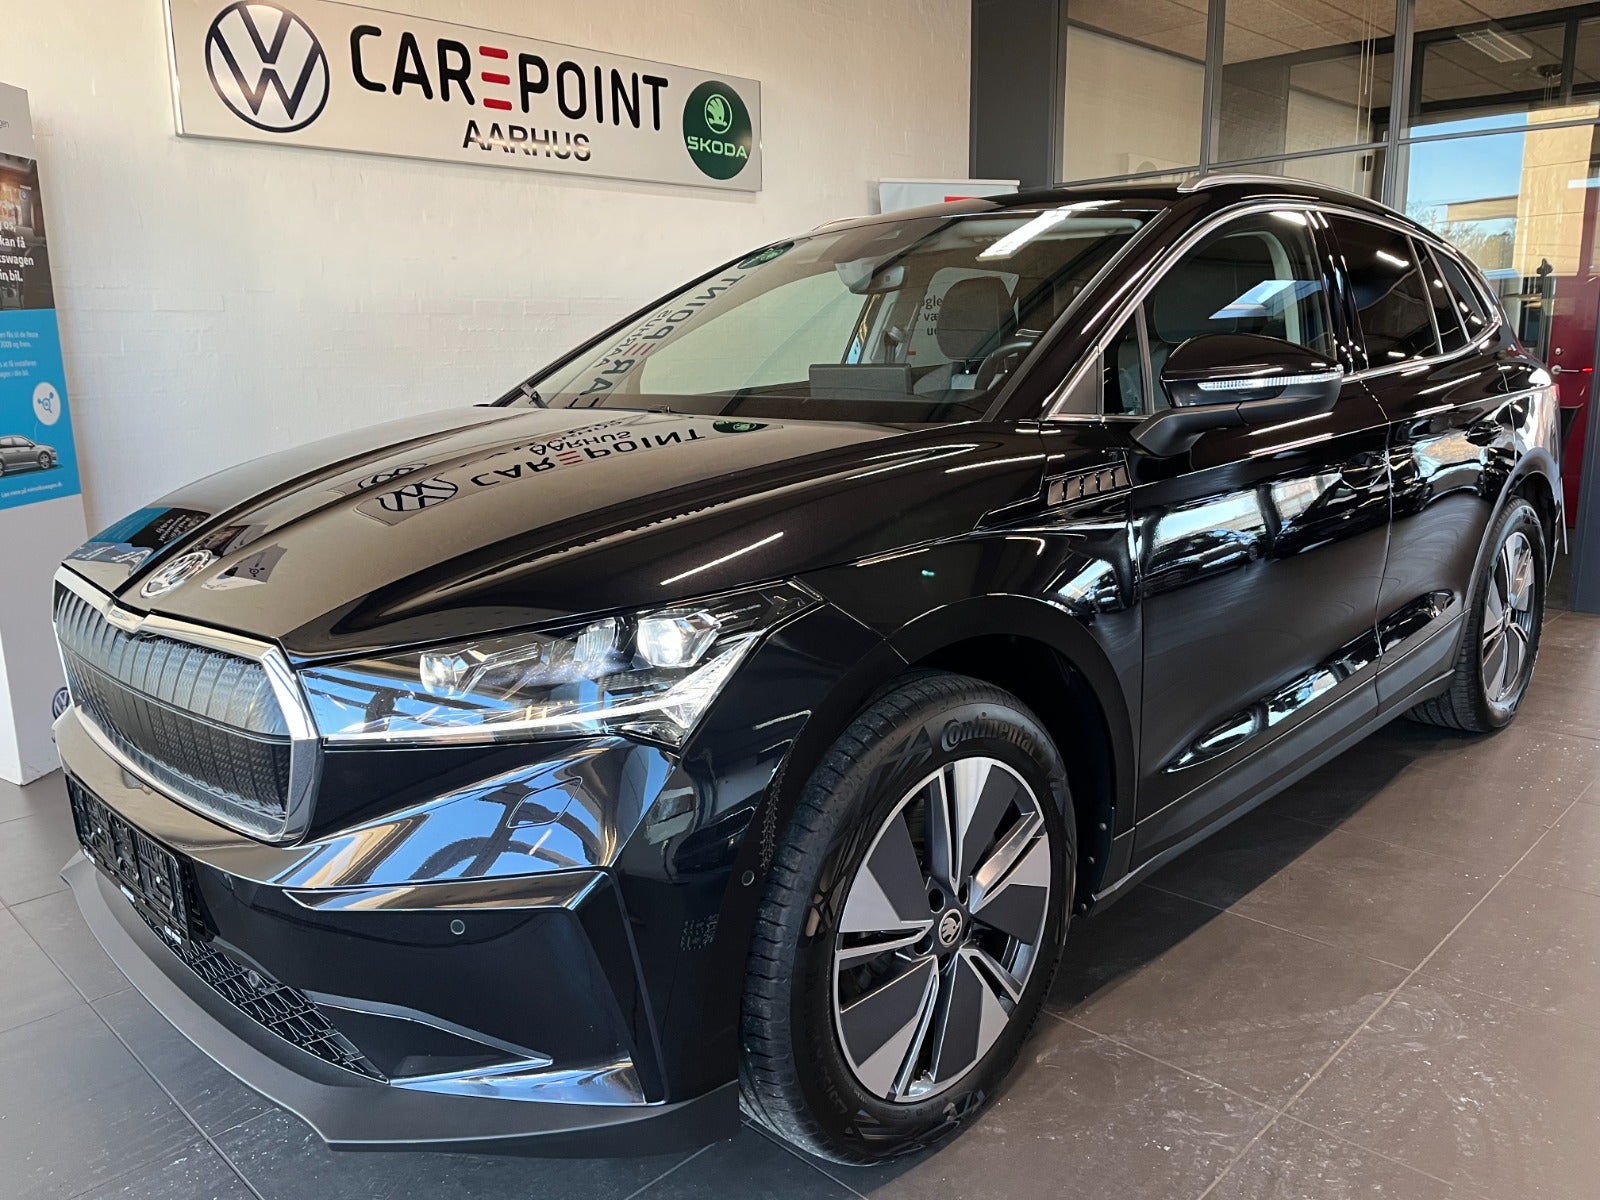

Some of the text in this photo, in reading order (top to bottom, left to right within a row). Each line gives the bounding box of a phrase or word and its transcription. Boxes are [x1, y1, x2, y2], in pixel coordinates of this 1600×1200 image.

[350, 25, 668, 131] CAREPOINT
[463, 119, 591, 162] AARHUS
[0, 254, 34, 268] swagen
[941, 712, 1039, 756] Continental
